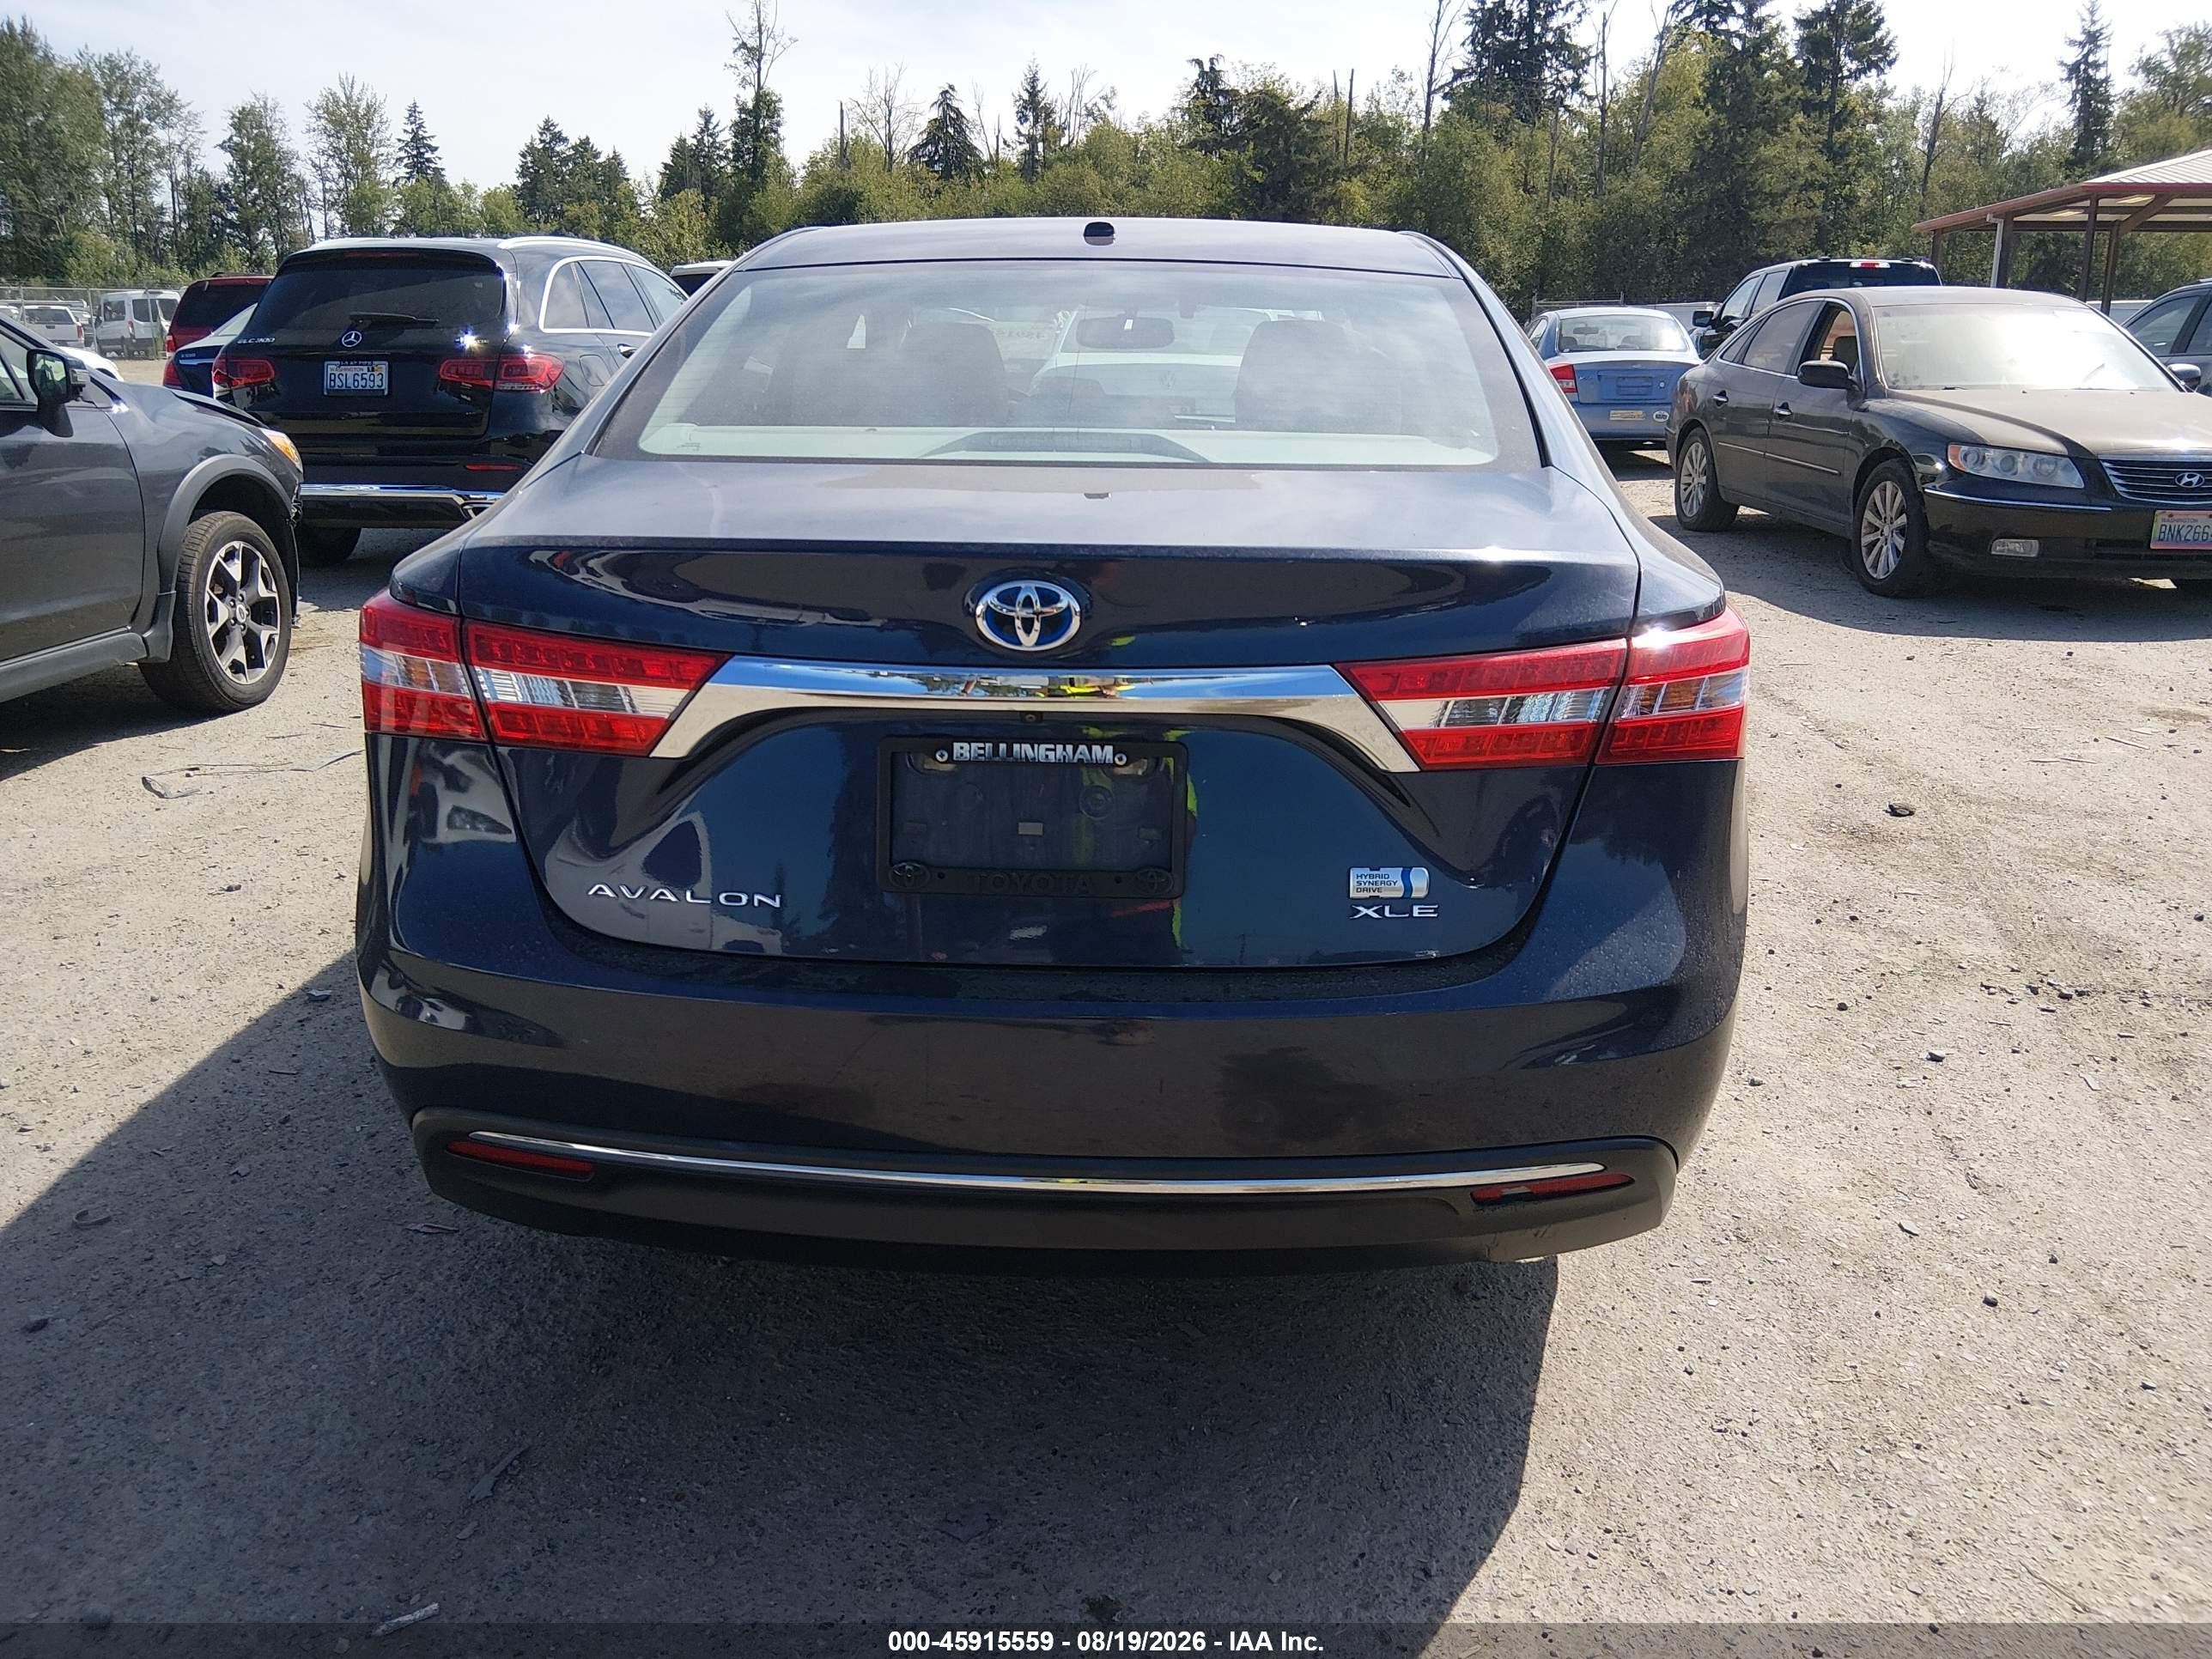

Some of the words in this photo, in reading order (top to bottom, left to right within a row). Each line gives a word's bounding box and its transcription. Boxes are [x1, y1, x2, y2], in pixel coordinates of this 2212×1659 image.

[329, 372, 384, 389] BSL6593
[2158, 524, 2212, 542] BNK266
[953, 742, 1114, 764] BELLINGHAM
[587, 884, 782, 908] AVALON
[1349, 904, 1439, 919] XLE
